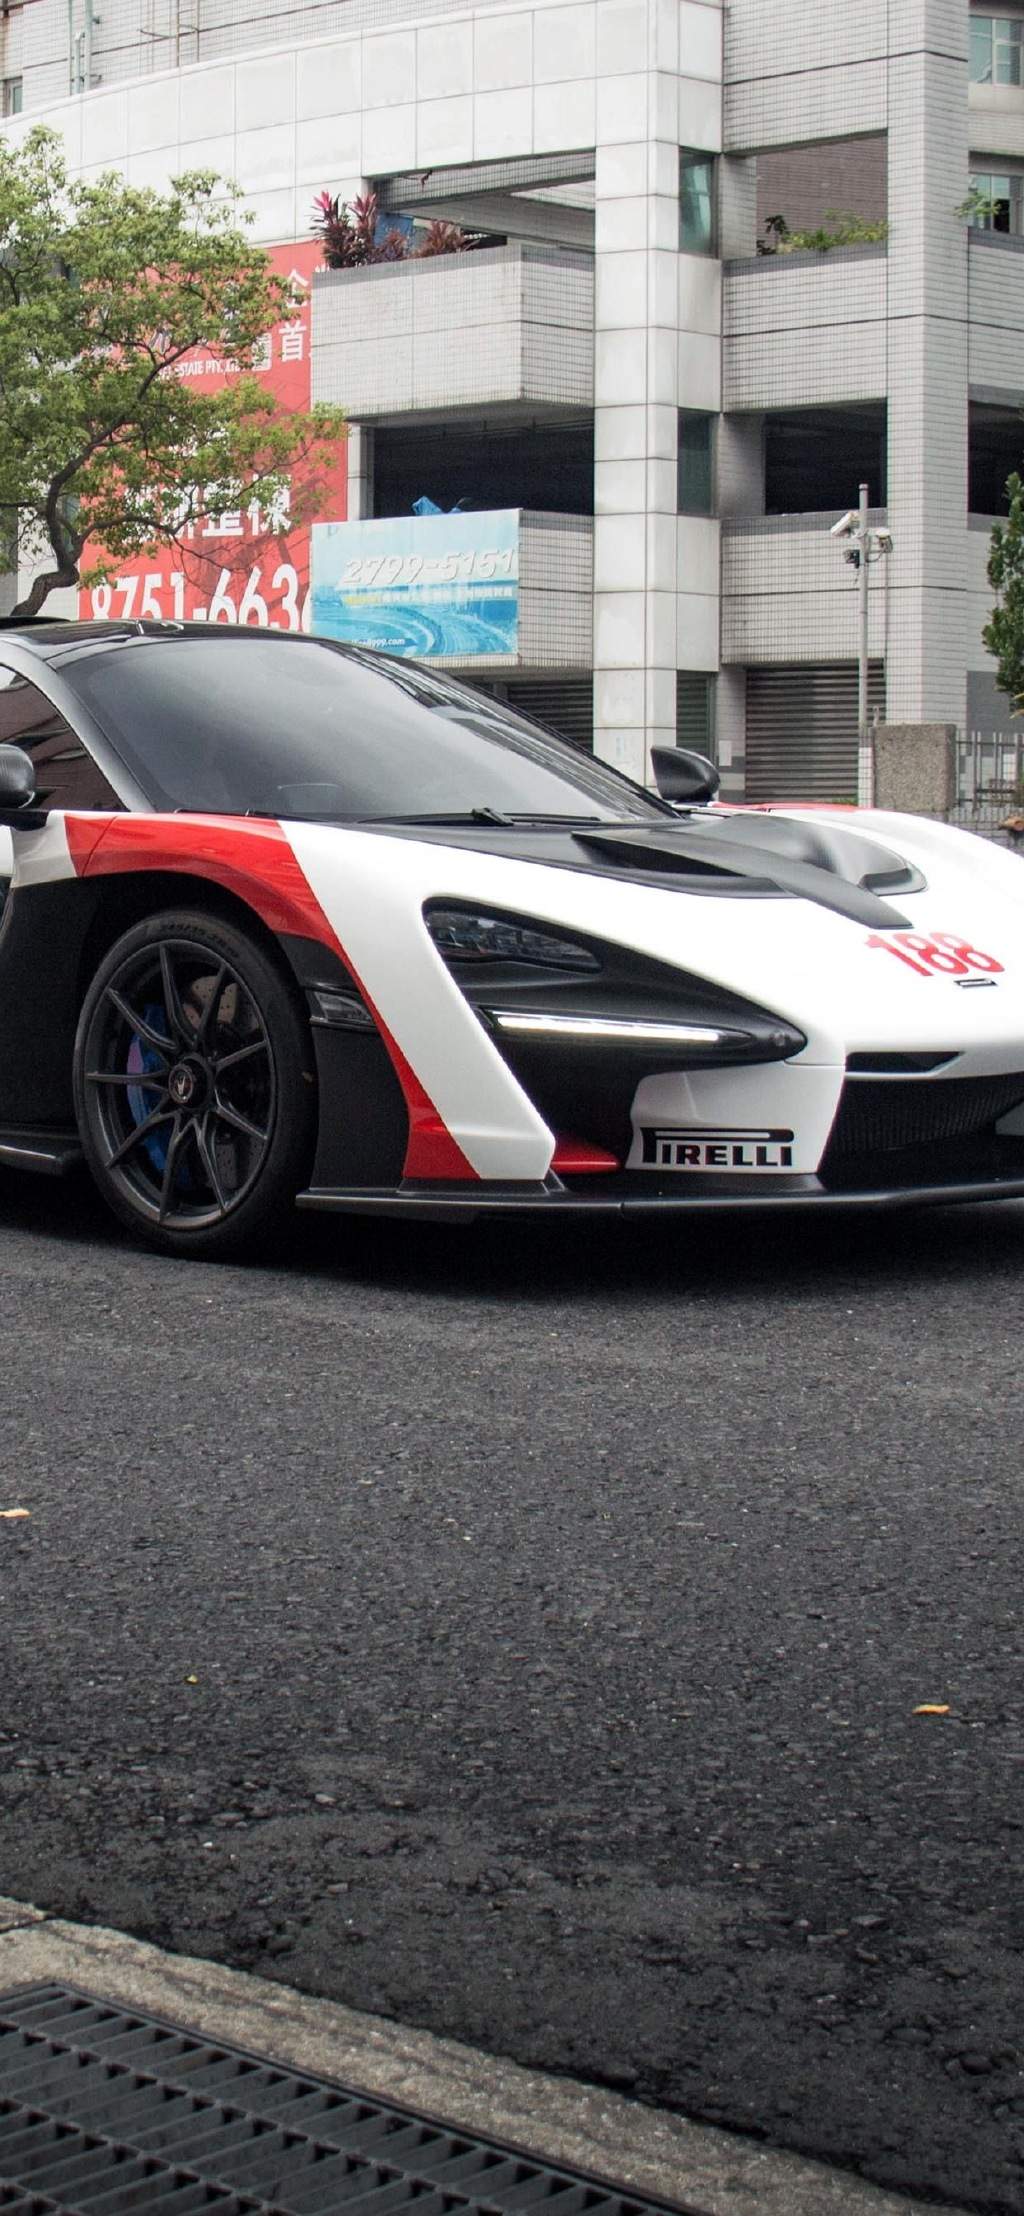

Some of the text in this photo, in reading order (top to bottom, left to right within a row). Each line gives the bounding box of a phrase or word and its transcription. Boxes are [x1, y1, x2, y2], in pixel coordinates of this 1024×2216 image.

[343, 549, 515, 585] 2799-5151
[865, 931, 1006, 977] 188
[639, 1126, 795, 1167] PIRELLI
